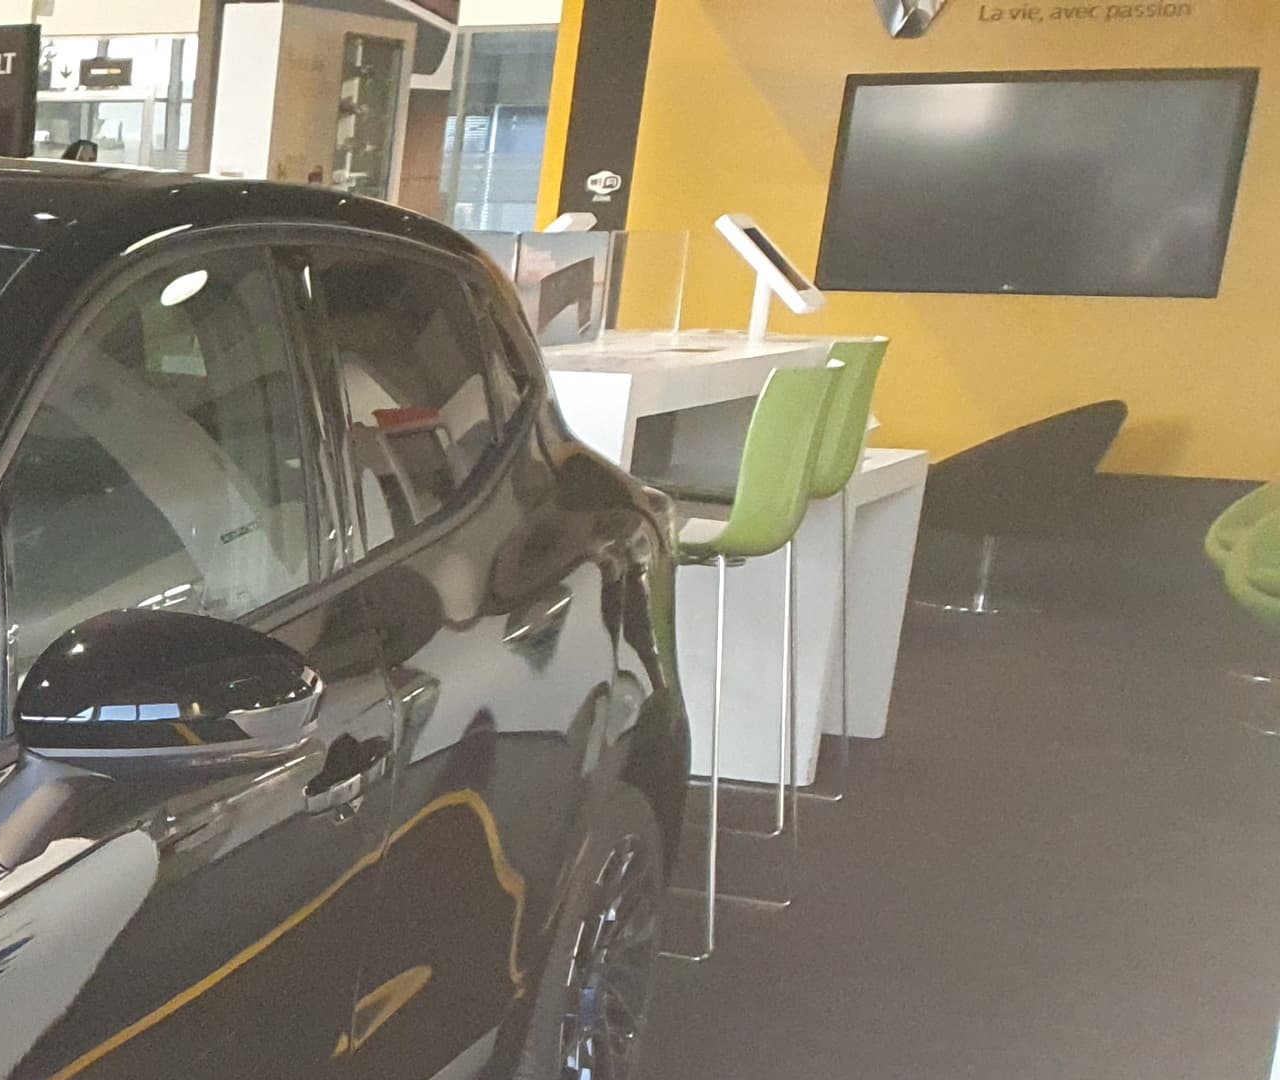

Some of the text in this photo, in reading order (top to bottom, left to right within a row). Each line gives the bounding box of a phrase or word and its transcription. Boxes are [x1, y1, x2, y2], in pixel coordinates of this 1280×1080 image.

[979, 0, 1191, 22] La vie, avec passion
